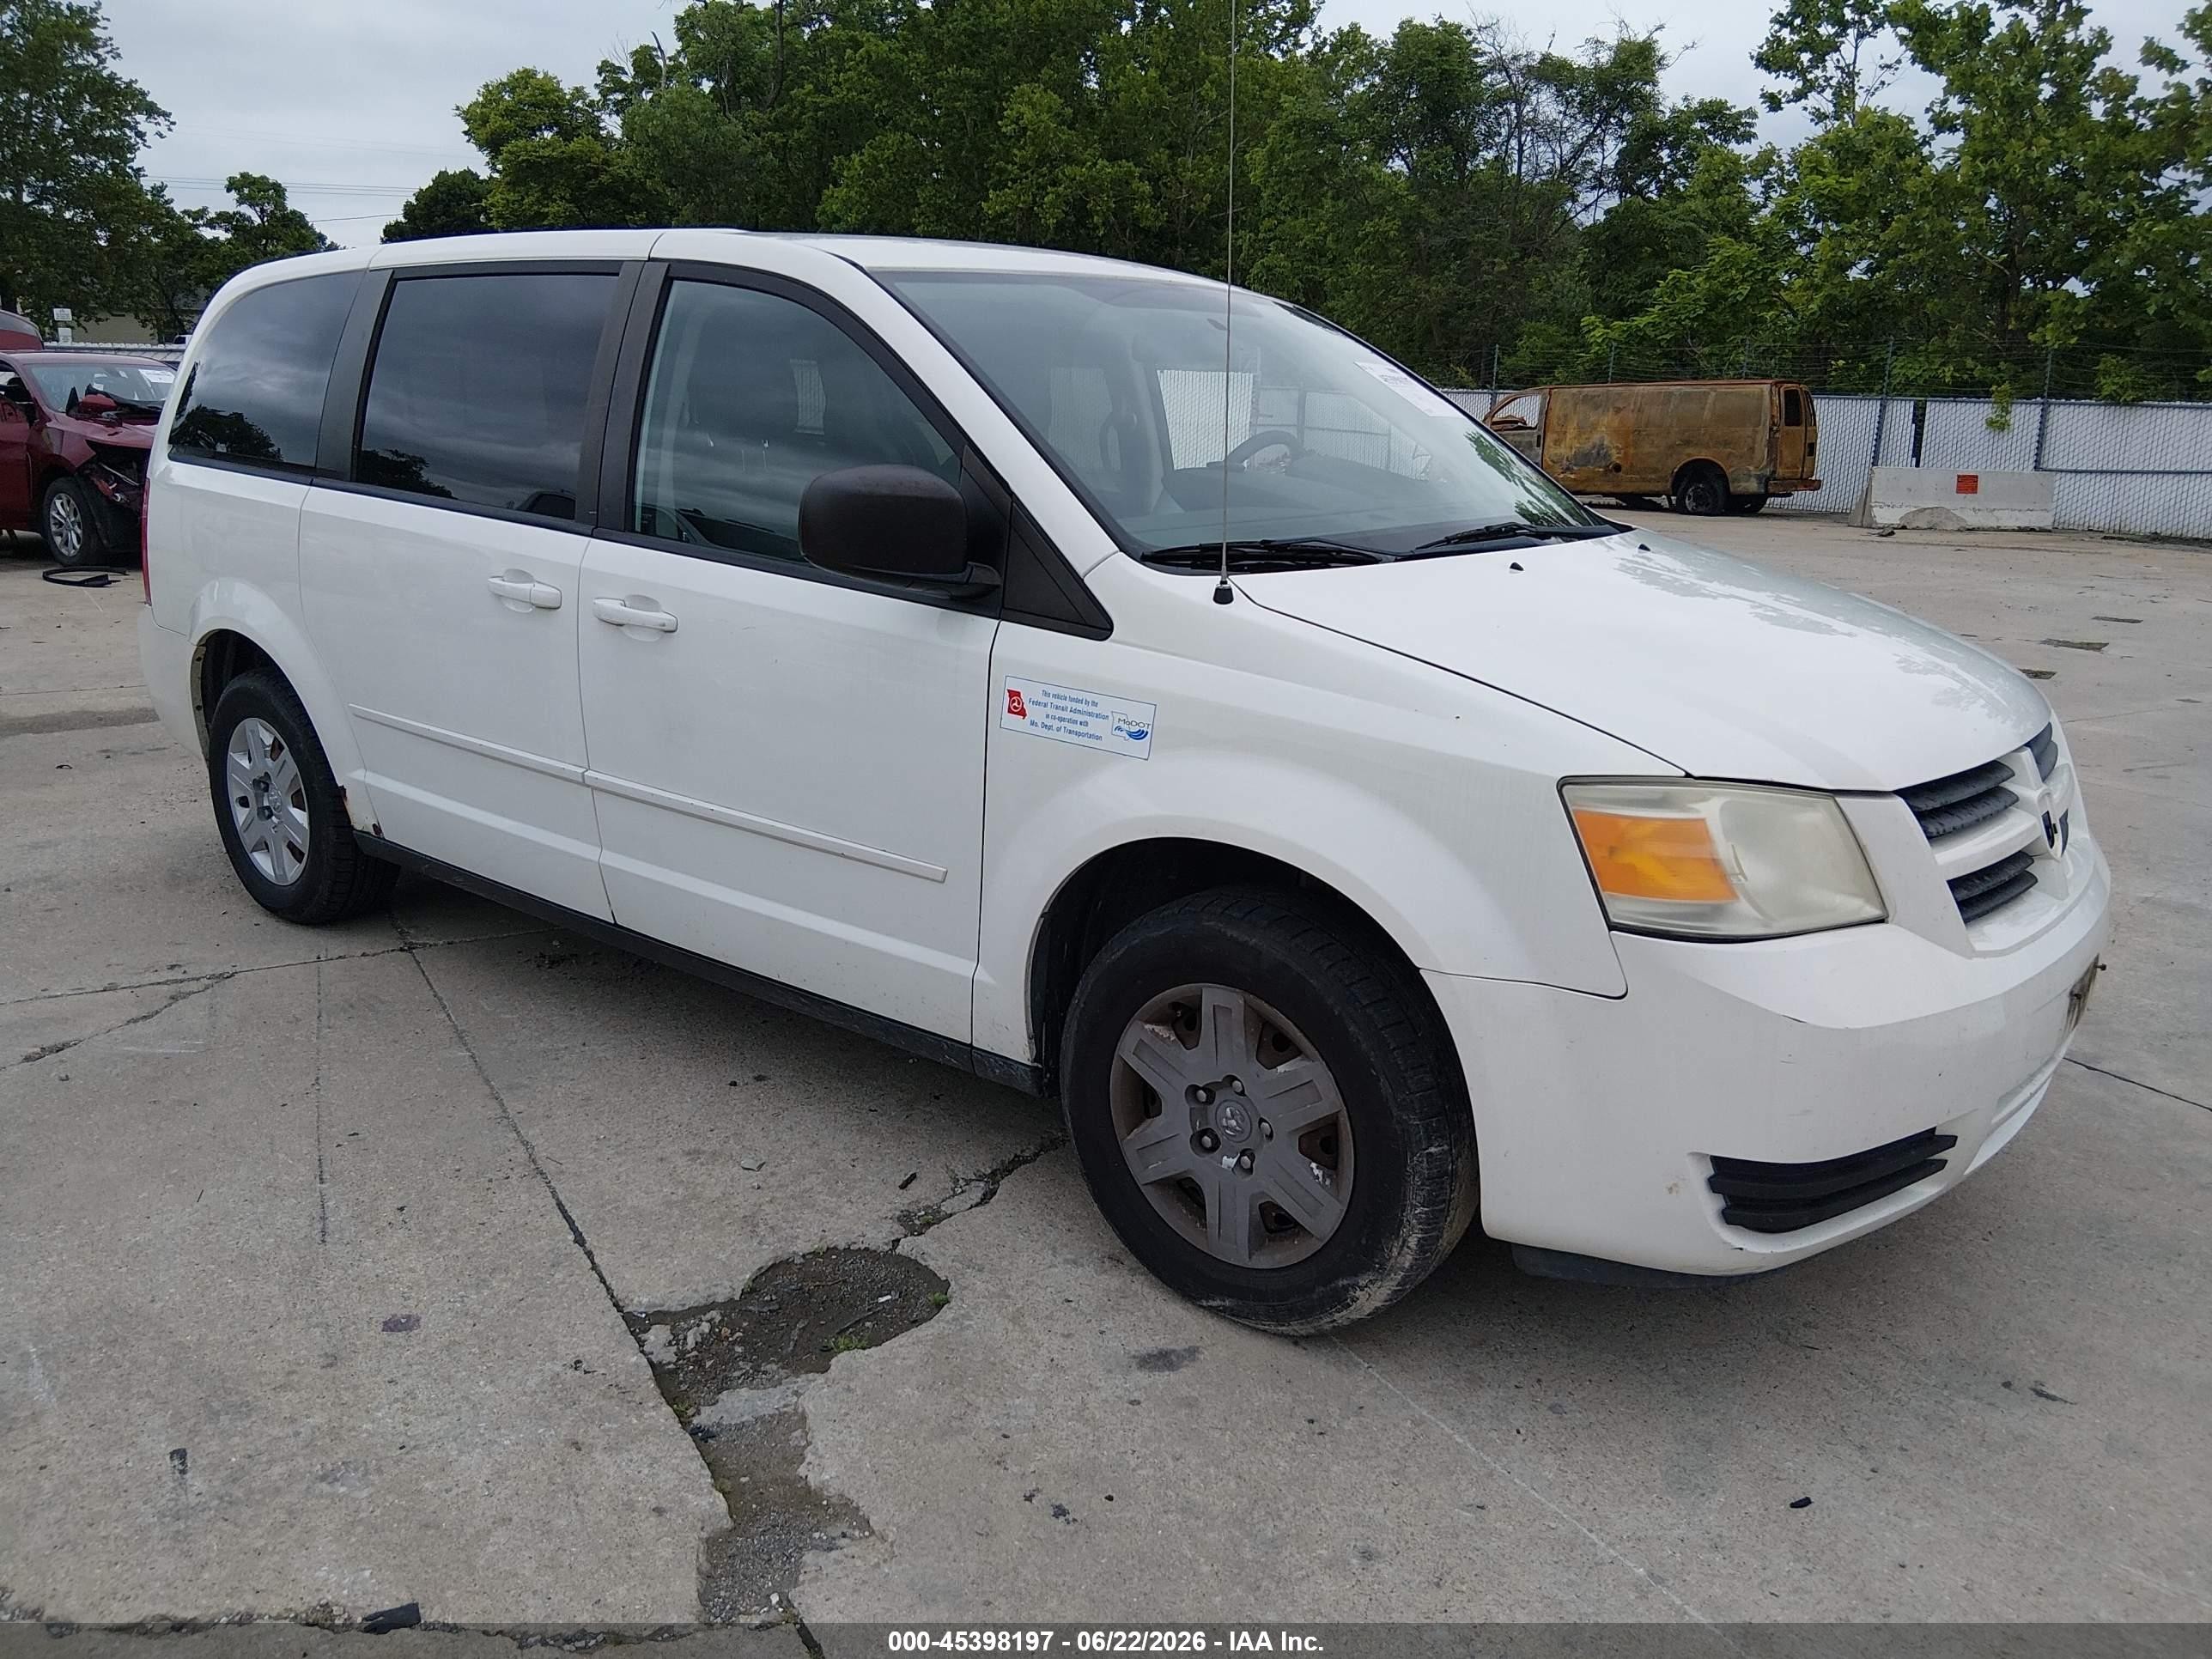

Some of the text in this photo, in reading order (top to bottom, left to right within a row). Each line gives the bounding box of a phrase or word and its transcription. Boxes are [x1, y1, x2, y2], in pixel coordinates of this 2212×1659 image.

[1052, 692, 1067, 702] vehicle
[1069, 696, 1084, 705] funded
[1029, 698, 1109, 720] Federal Transit Administration
[1118, 718, 1151, 728] MoDOT
[1041, 722, 1054, 732] Dept.
[1063, 726, 1103, 741] Transportation
